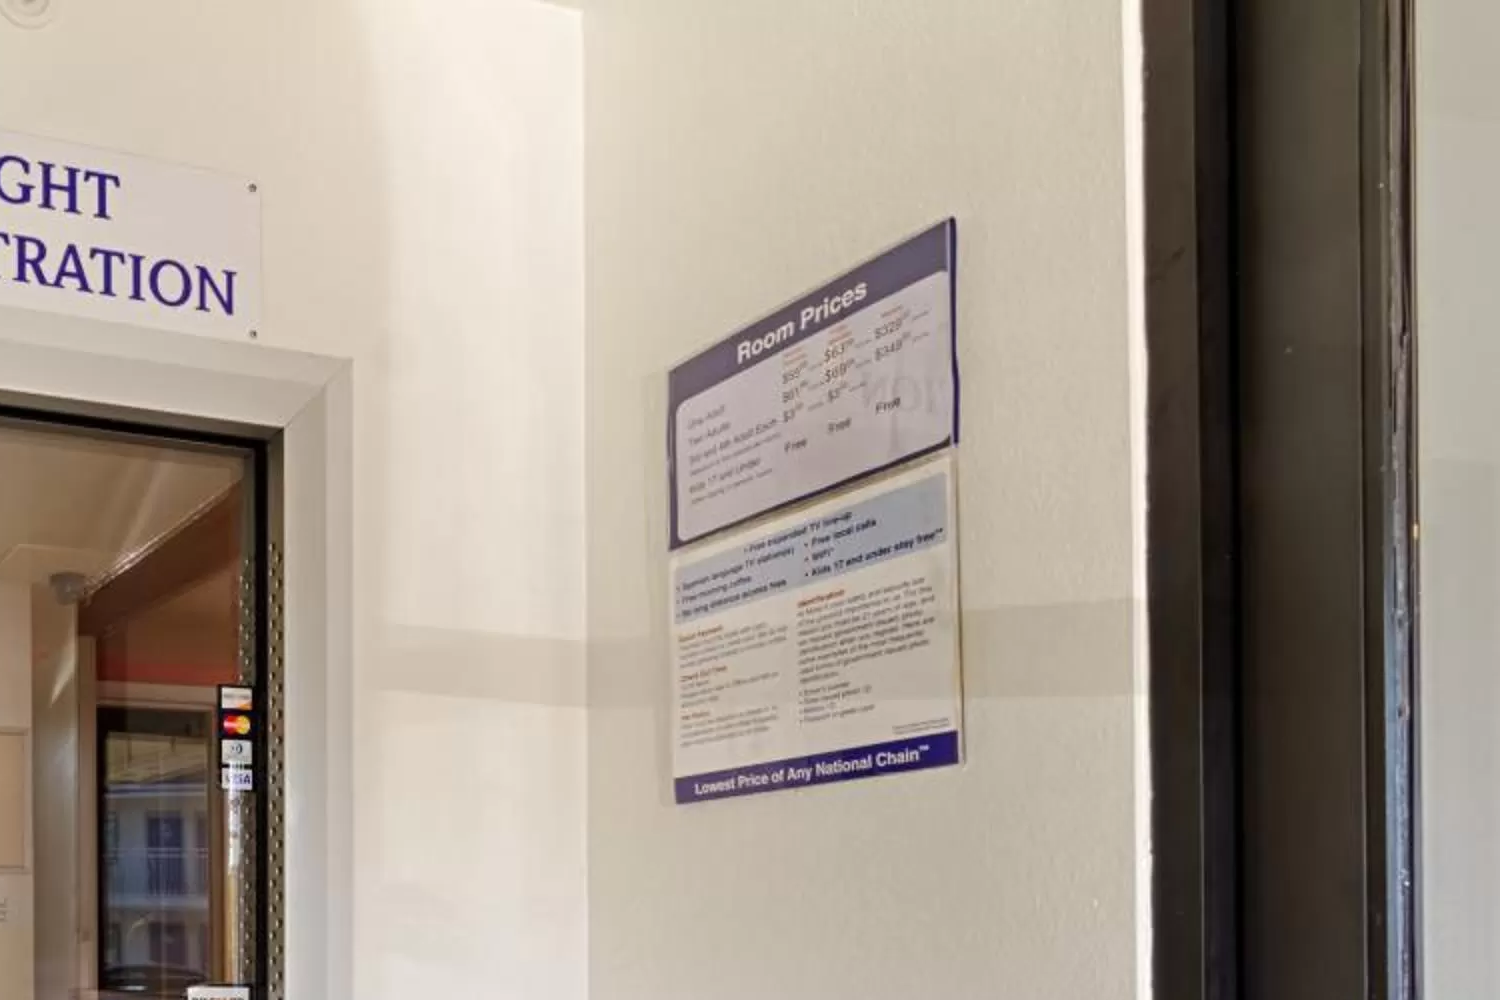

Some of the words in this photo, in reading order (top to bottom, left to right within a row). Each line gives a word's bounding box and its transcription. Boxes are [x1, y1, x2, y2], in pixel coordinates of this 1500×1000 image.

[737, 320, 795, 364] Room
[800, 282, 868, 329] Prices
[694, 778, 737, 796] Lowest
[737, 773, 769, 790] Price
[771, 768, 785, 784] of
[786, 764, 813, 783] Any
[815, 754, 874, 776] National
